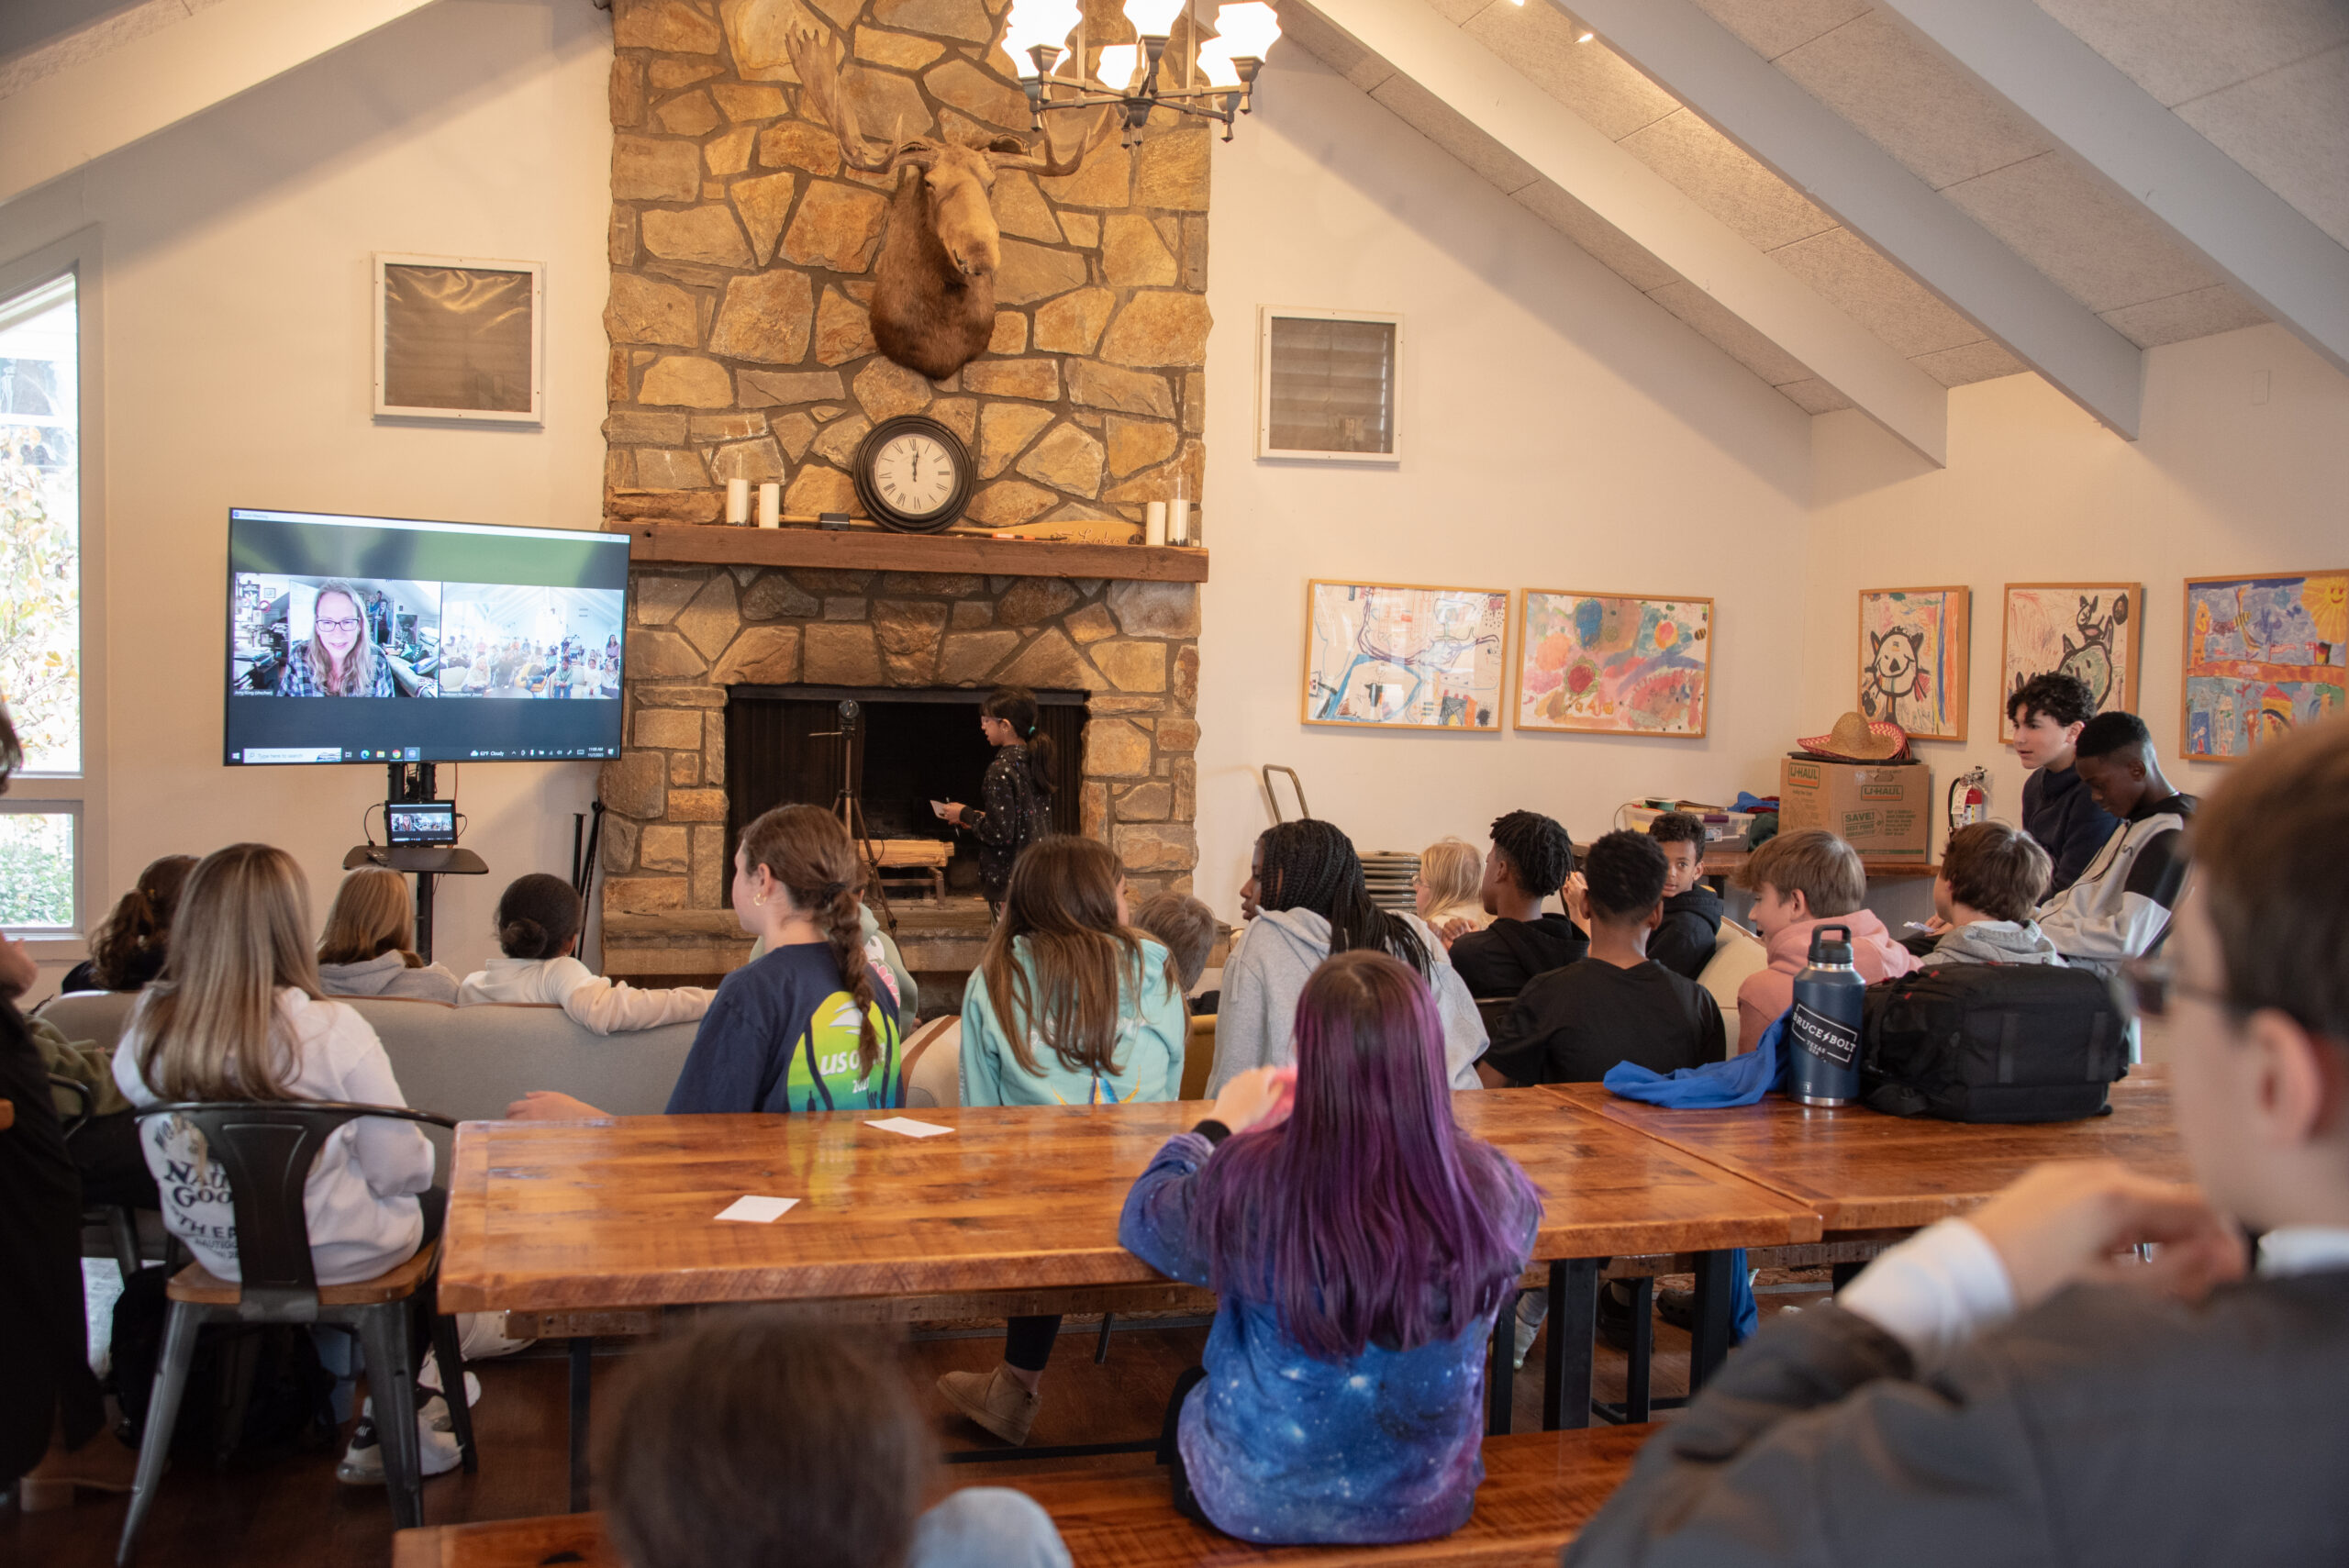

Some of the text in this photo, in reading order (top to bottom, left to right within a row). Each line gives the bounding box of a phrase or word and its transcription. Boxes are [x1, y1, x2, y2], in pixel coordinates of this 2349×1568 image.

[1845, 812, 1875, 823] SAVE!
[1792, 1012, 1856, 1053] BRUCE BOLT
[1806, 1040, 1826, 1054] TEXAS
